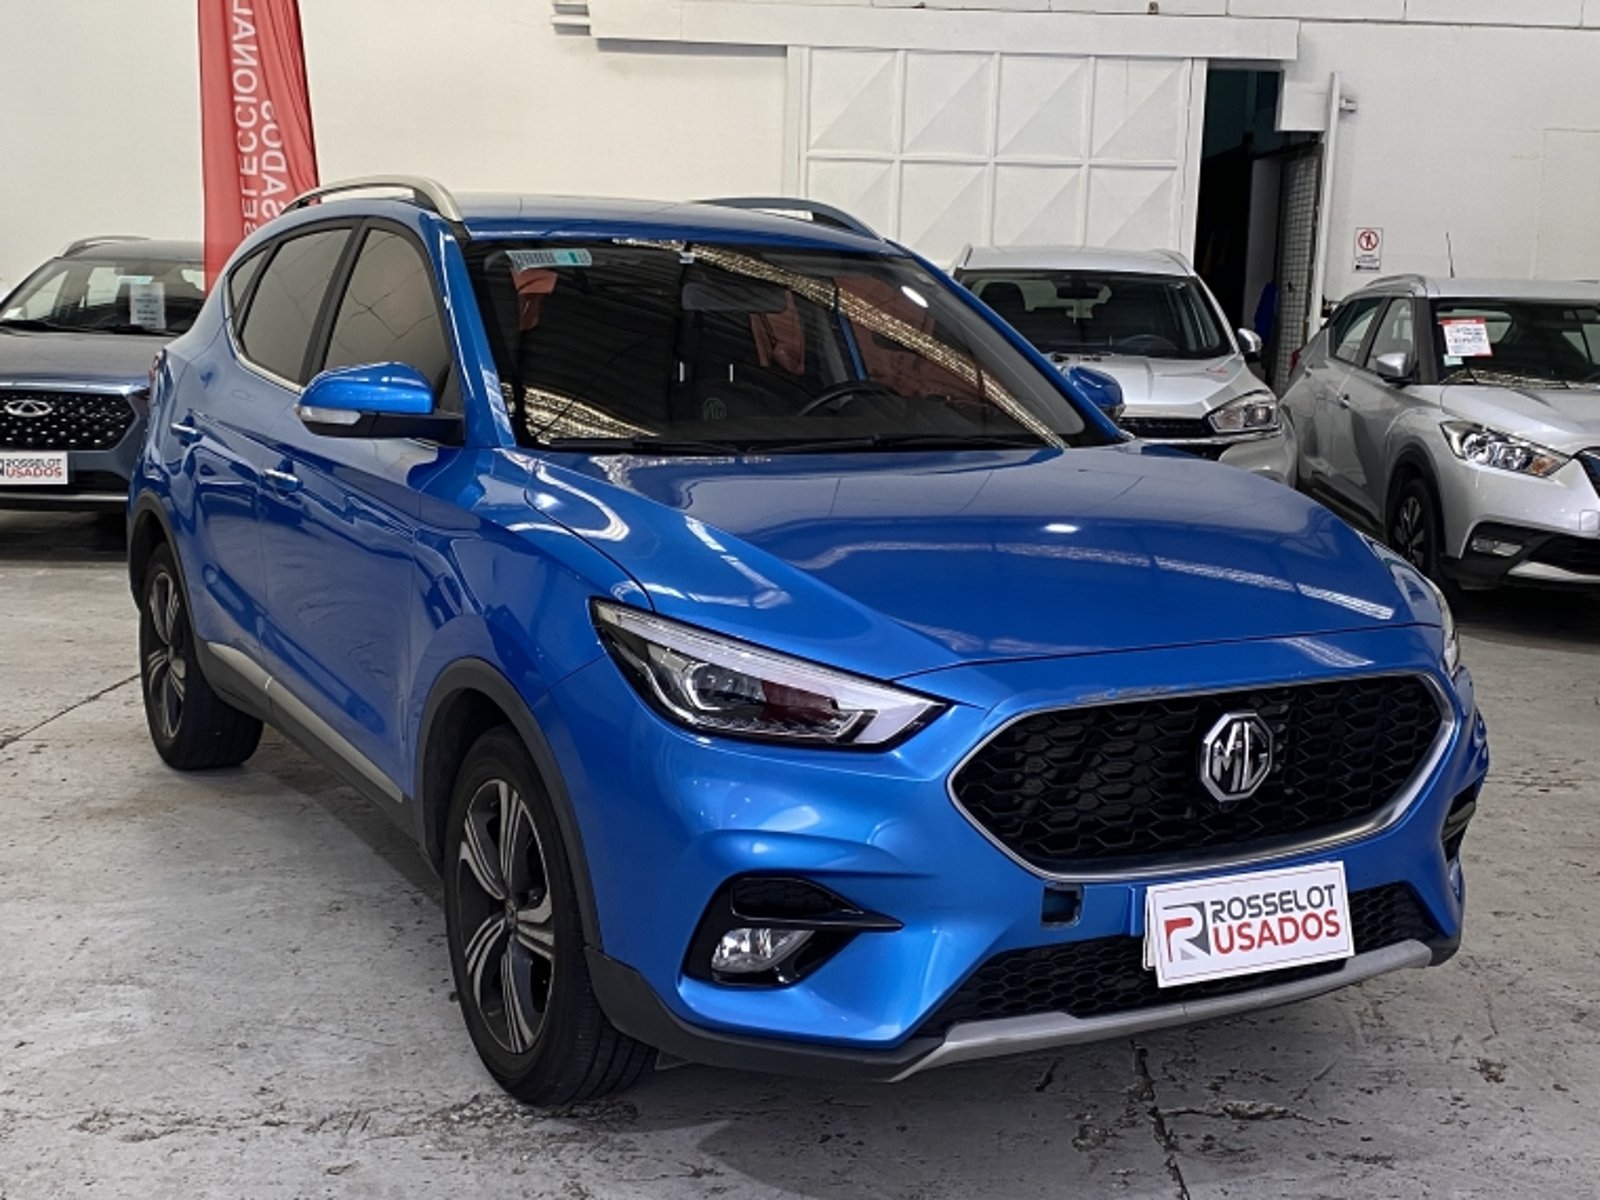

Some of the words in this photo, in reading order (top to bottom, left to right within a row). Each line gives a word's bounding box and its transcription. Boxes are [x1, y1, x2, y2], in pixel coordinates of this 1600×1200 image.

[6, 467, 62, 478] USADOS
[1212, 721, 1269, 792] MG
[1210, 884, 1336, 924] ROSSELOT
[1213, 909, 1341, 955] USADOS
